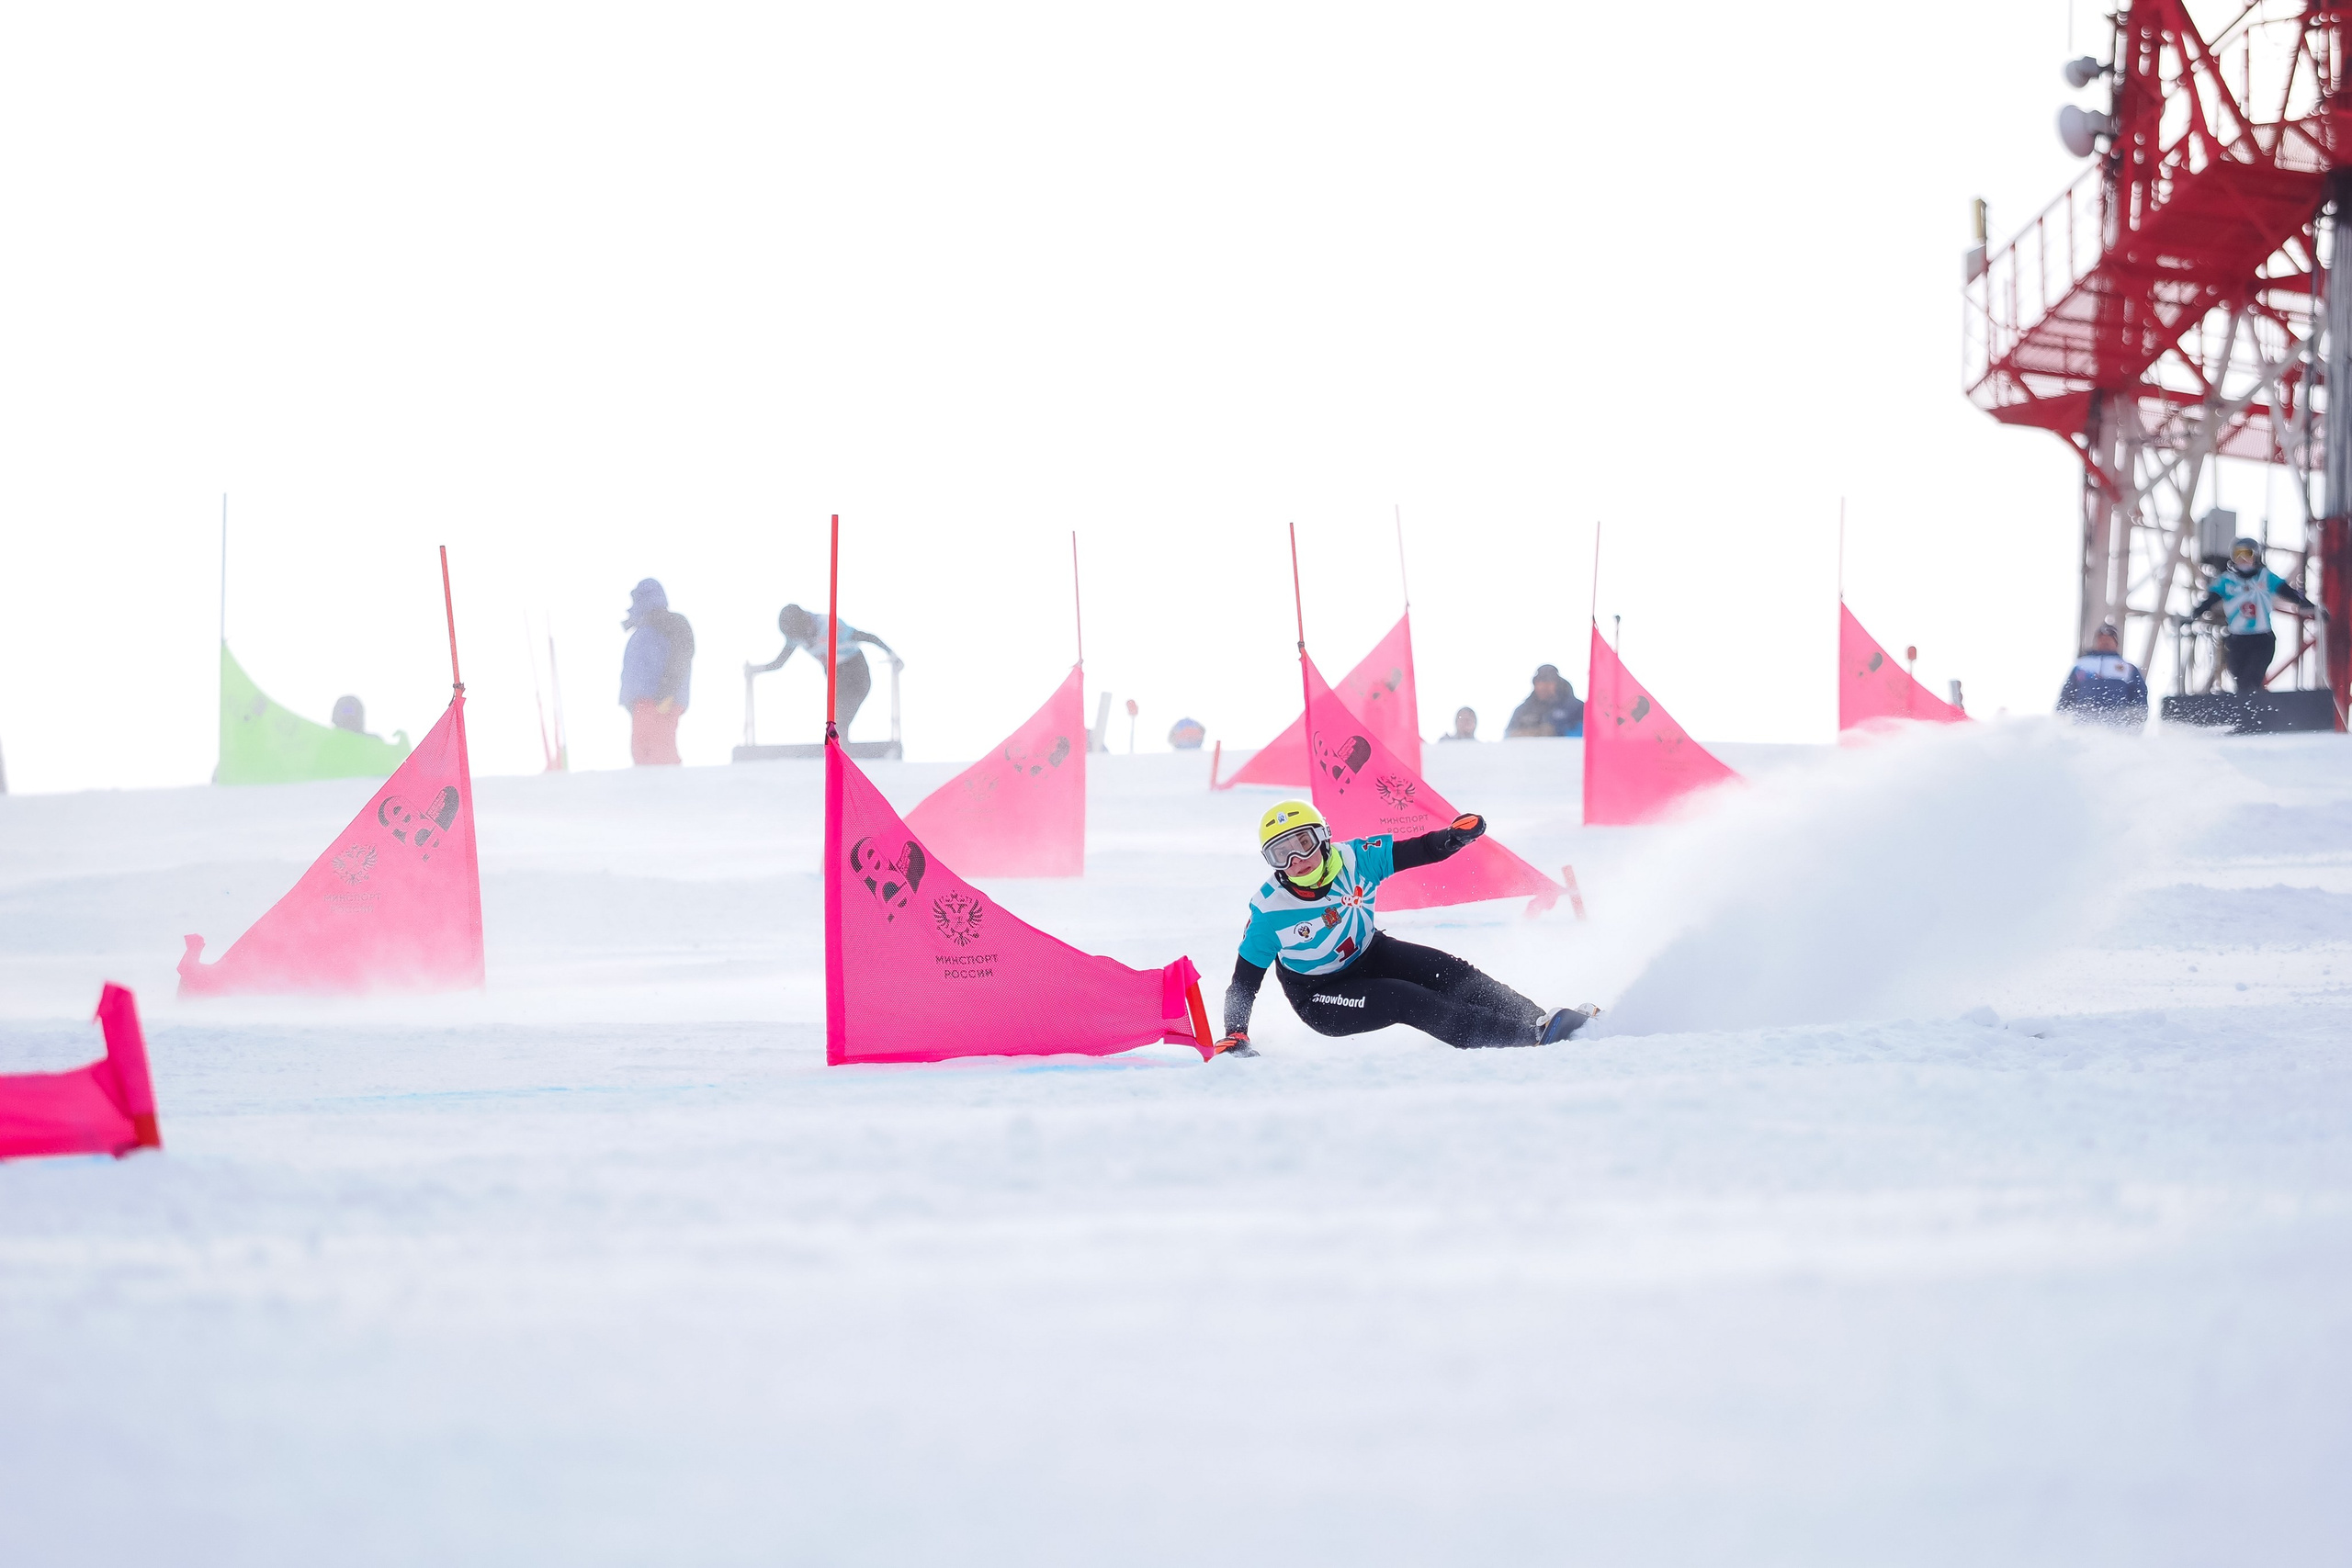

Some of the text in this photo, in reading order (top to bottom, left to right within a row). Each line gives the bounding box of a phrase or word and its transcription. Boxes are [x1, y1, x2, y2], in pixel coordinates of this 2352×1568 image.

[1379, 814, 1429, 825] МИНСПОРТ
[1387, 825, 1425, 834] РОССИИ
[323, 892, 381, 903] МИНСПОРТ
[1334, 935, 1360, 963] 1
[935, 953, 999, 964] МИНСПОРТ
[944, 968, 994, 979] РОССИИ
